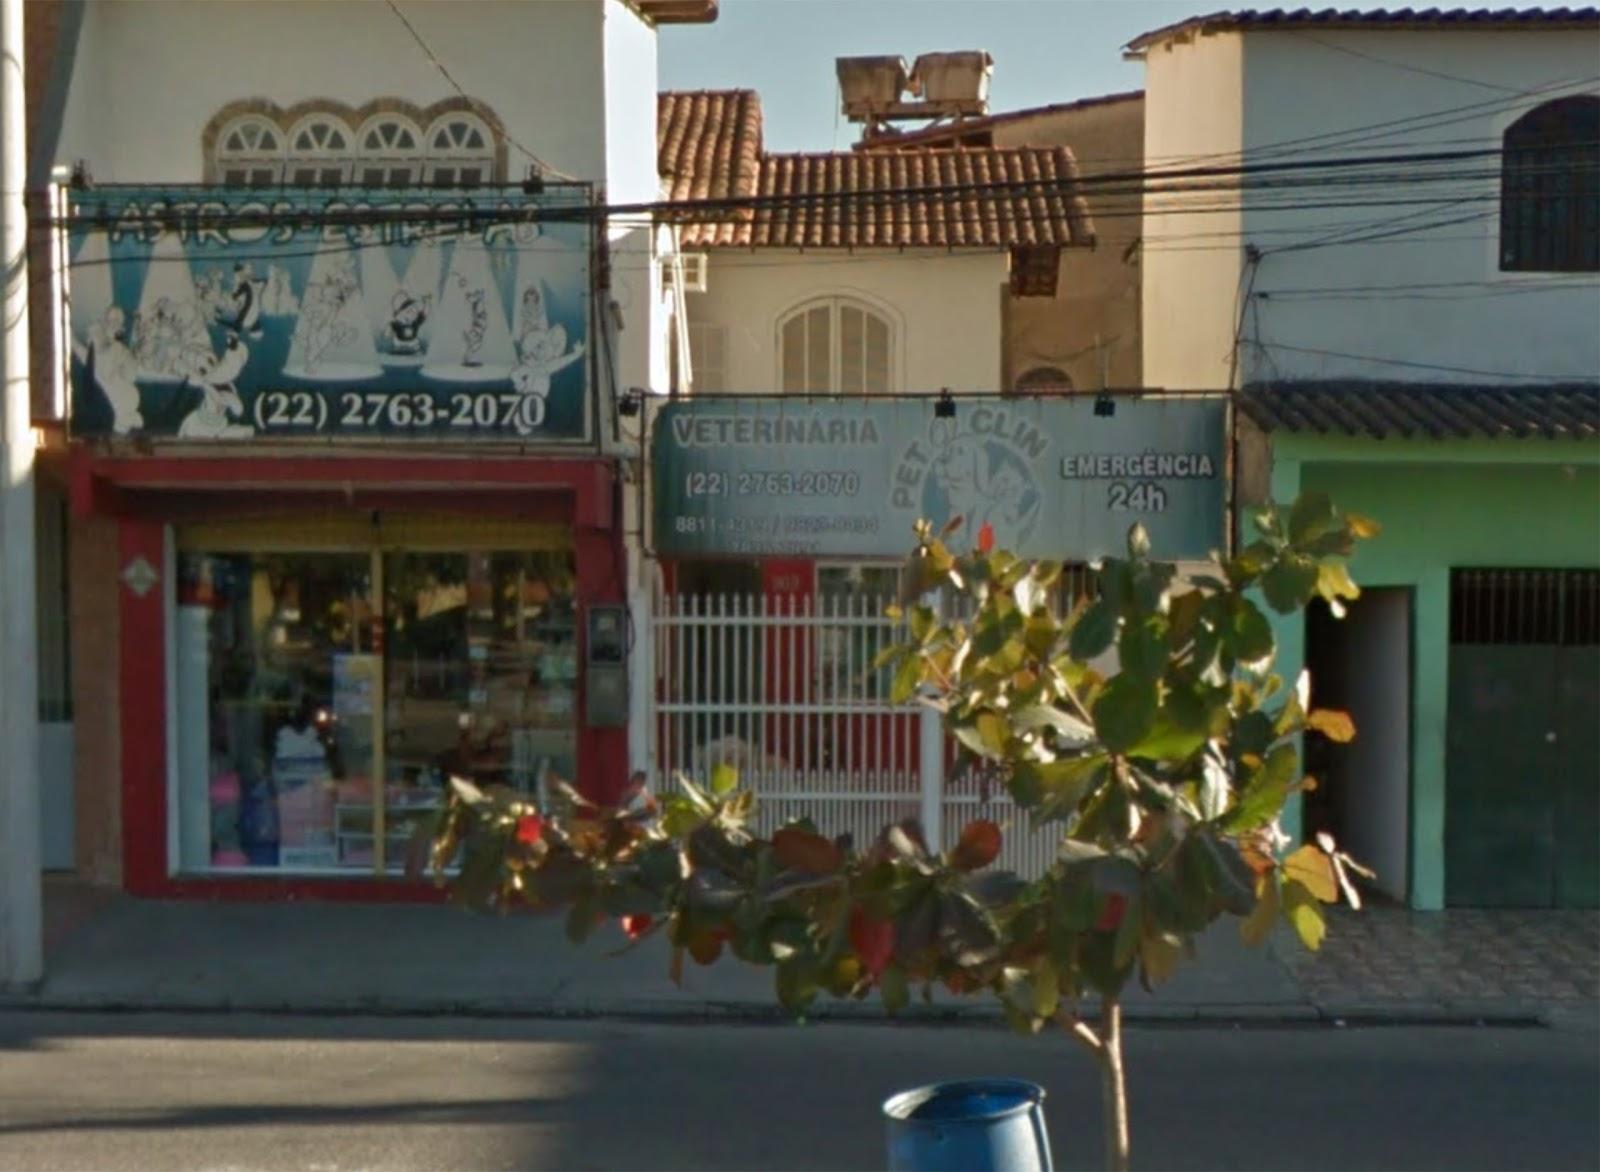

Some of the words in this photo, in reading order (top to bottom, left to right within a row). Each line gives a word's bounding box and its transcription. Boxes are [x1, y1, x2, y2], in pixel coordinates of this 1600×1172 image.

[253, 391, 328, 428] (22)
[341, 392, 546, 428] 2763-2070
[892, 441, 930, 510] PET
[970, 408, 1050, 459] CLIN
[1060, 450, 1215, 479] EMERGÊNCIA
[685, 472, 729, 499] (22)
[738, 472, 860, 497] 2763-2070
[1108, 483, 1167, 512] 24h
